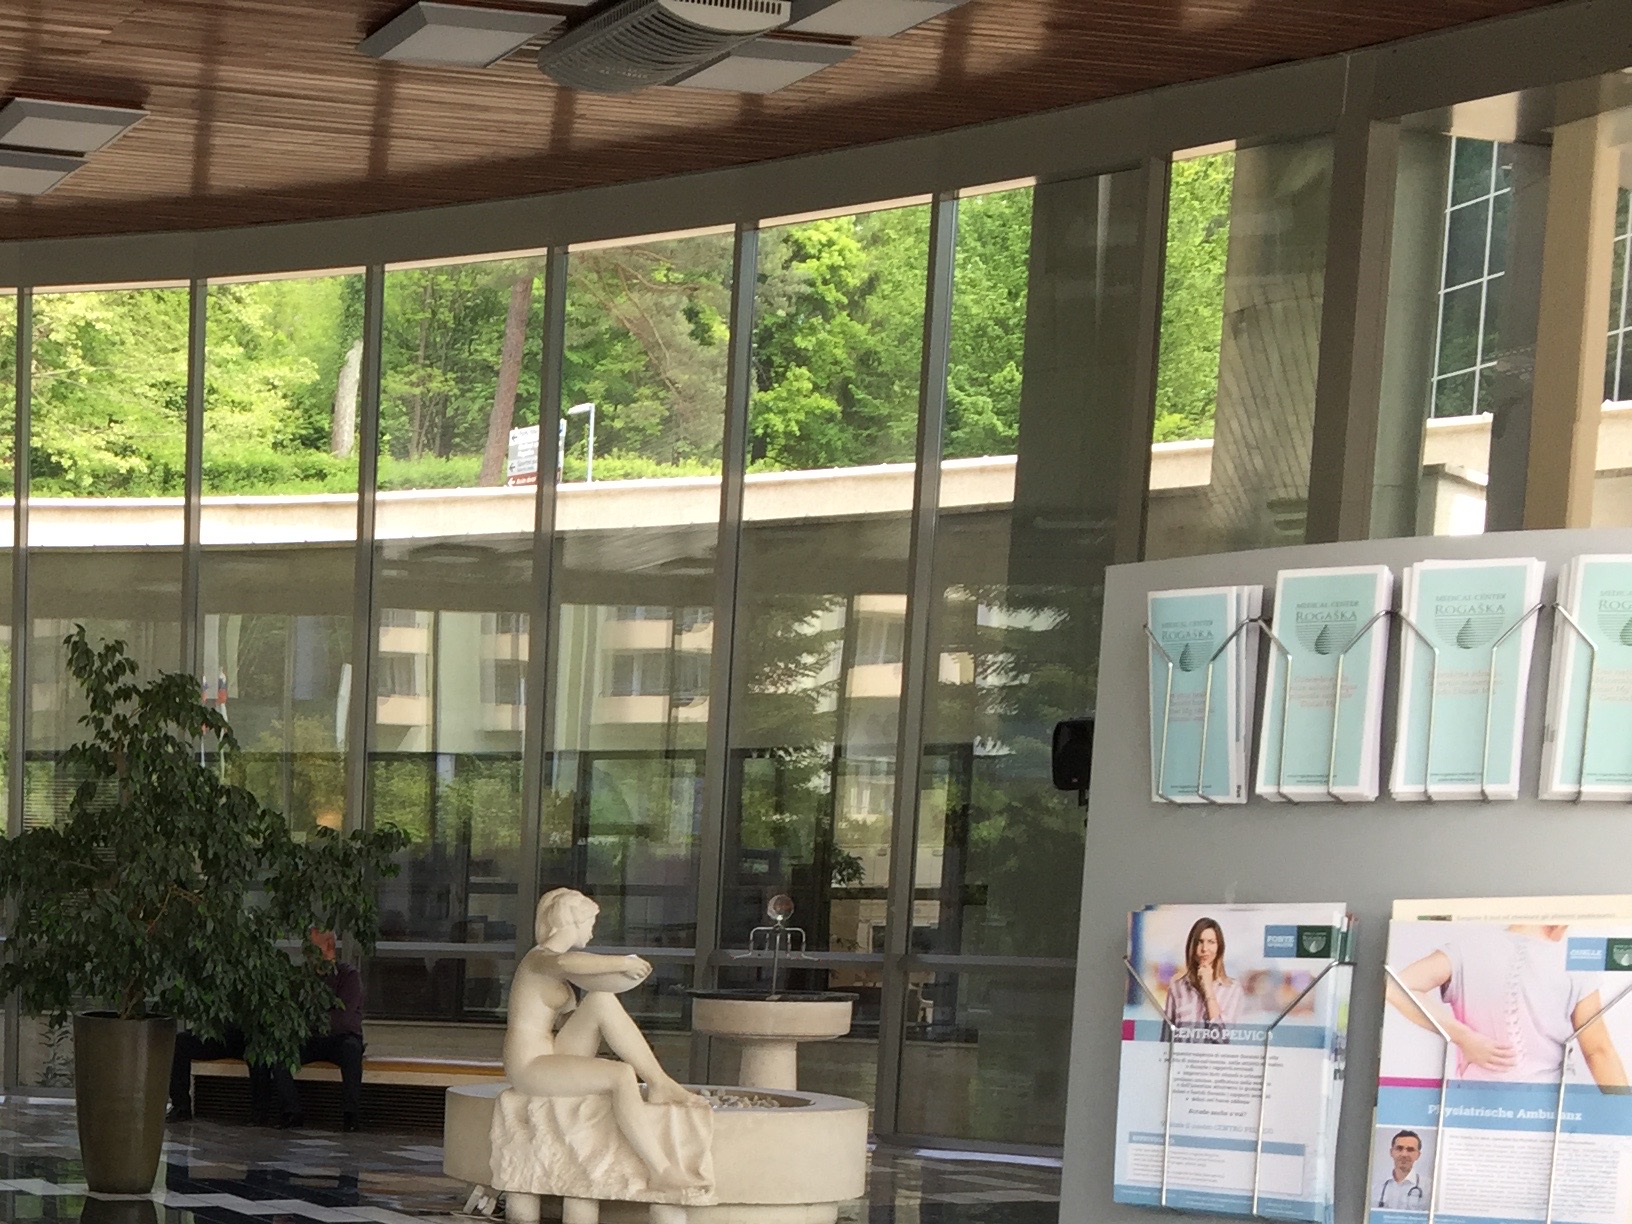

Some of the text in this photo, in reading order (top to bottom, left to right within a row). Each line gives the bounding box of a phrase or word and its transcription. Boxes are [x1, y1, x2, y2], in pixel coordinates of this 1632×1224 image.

[1295, 609, 1358, 621] ROGAŠKA
[1435, 602, 1506, 615] ROGAŠKA
[1161, 629, 1214, 640] ROGAŠKA
[1172, 1027, 1220, 1040] CENTRO
[1516, 1108, 1583, 1121] Ambuanz
